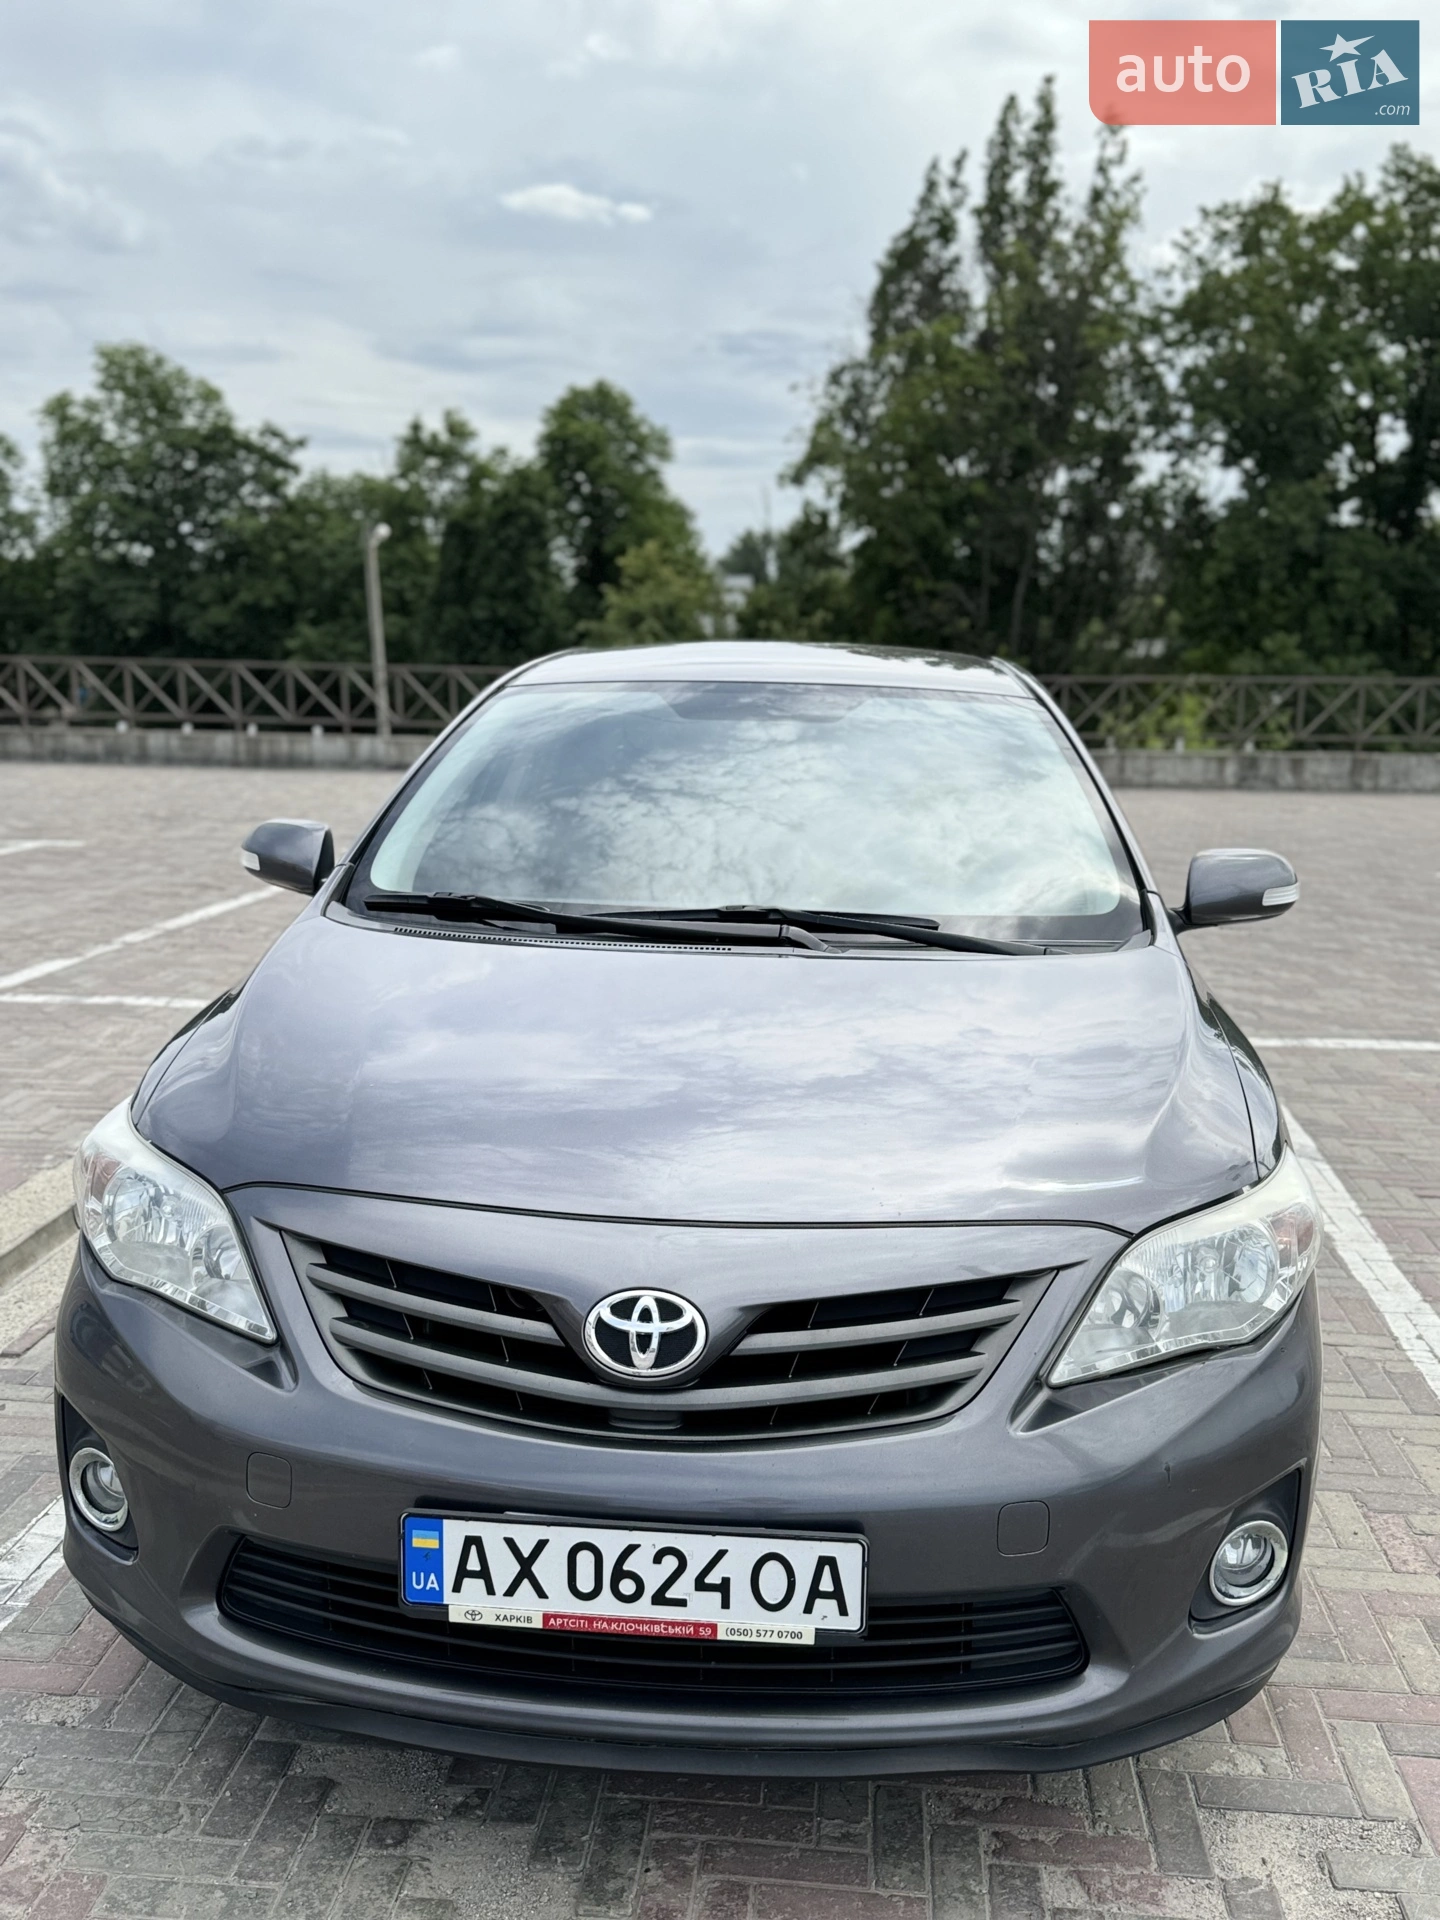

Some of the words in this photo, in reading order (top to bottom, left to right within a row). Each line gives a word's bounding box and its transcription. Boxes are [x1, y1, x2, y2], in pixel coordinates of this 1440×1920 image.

[411, 1571, 440, 1592] UA
[567, 1541, 731, 1610] 0624
[495, 1613, 533, 1624] ХАРКІВ
[699, 1626, 712, 1636] 59
[725, 1627, 753, 1638] (050)
[755, 1629, 774, 1639] 577
[777, 1630, 803, 1640] 0700
